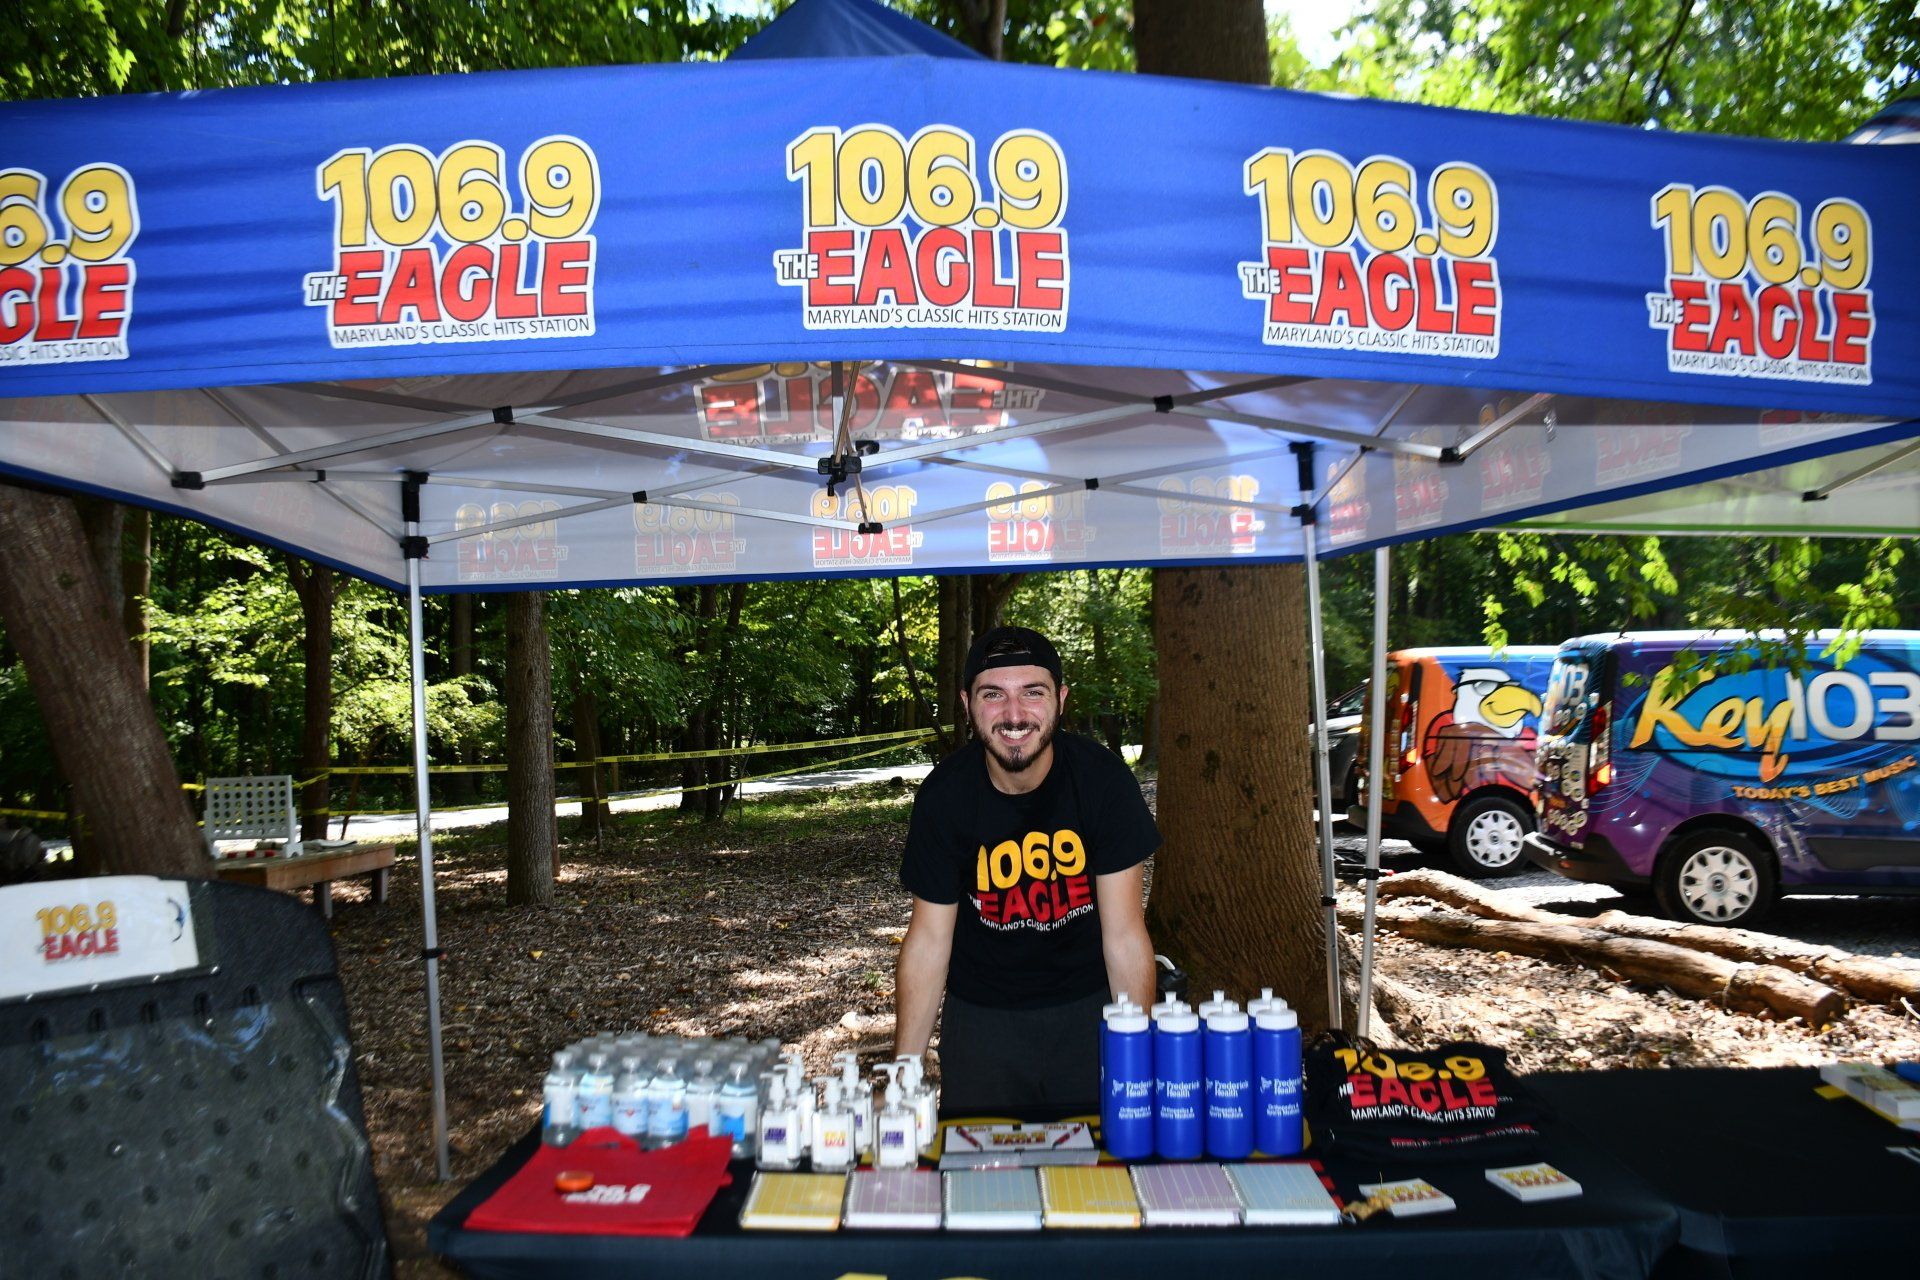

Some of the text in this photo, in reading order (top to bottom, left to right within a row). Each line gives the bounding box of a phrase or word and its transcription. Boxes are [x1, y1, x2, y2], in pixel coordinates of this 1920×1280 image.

[322, 140, 595, 248] 106.9
[791, 129, 1063, 230] 106.9
[1249, 152, 1494, 258] 106.9
[1656, 188, 1869, 290] 106.9
[309, 241, 591, 327] THE EAGLE
[779, 226, 1064, 310] THE EAGLE
[1243, 246, 1496, 336] THE EAGLE
[334, 318, 590, 344] MARYLAND'S CLASSIC HITS STATION
[808, 308, 1062, 328] MARYLAND'S CLASSIC HITS STATION
[1267, 325, 1495, 354] MARYLAND'S CLASSIC HITS STATION
[1652, 278, 1870, 364] THE EAGLE
[30, 344, 60, 360] HITS
[63, 340, 123, 358] STATION
[1750, 357, 1794, 376] CLASSIC
[1797, 362, 1821, 378] HITS
[1822, 363, 1868, 381] STATION
[1628, 664, 1794, 783] Key
[1785, 671, 1920, 741] 103
[1732, 755, 1918, 801] TODAY'S BEST MUSIC
[35, 900, 117, 937] 106.9
[976, 874, 1092, 923] EAGLE
[980, 915, 1025, 932] MARYLAND'S
[1052, 916, 1067, 930] HITS
[1067, 902, 1094, 921] STATION
[43, 928, 119, 960] EAGLE
[1334, 1048, 1486, 1081] 106.9
[1338, 1073, 1498, 1113] HE EAGLE
[1351, 1104, 1409, 1121] MARYLAND'S
[1444, 1106, 1465, 1123] HITS
[1465, 1106, 1495, 1120] STATIO
